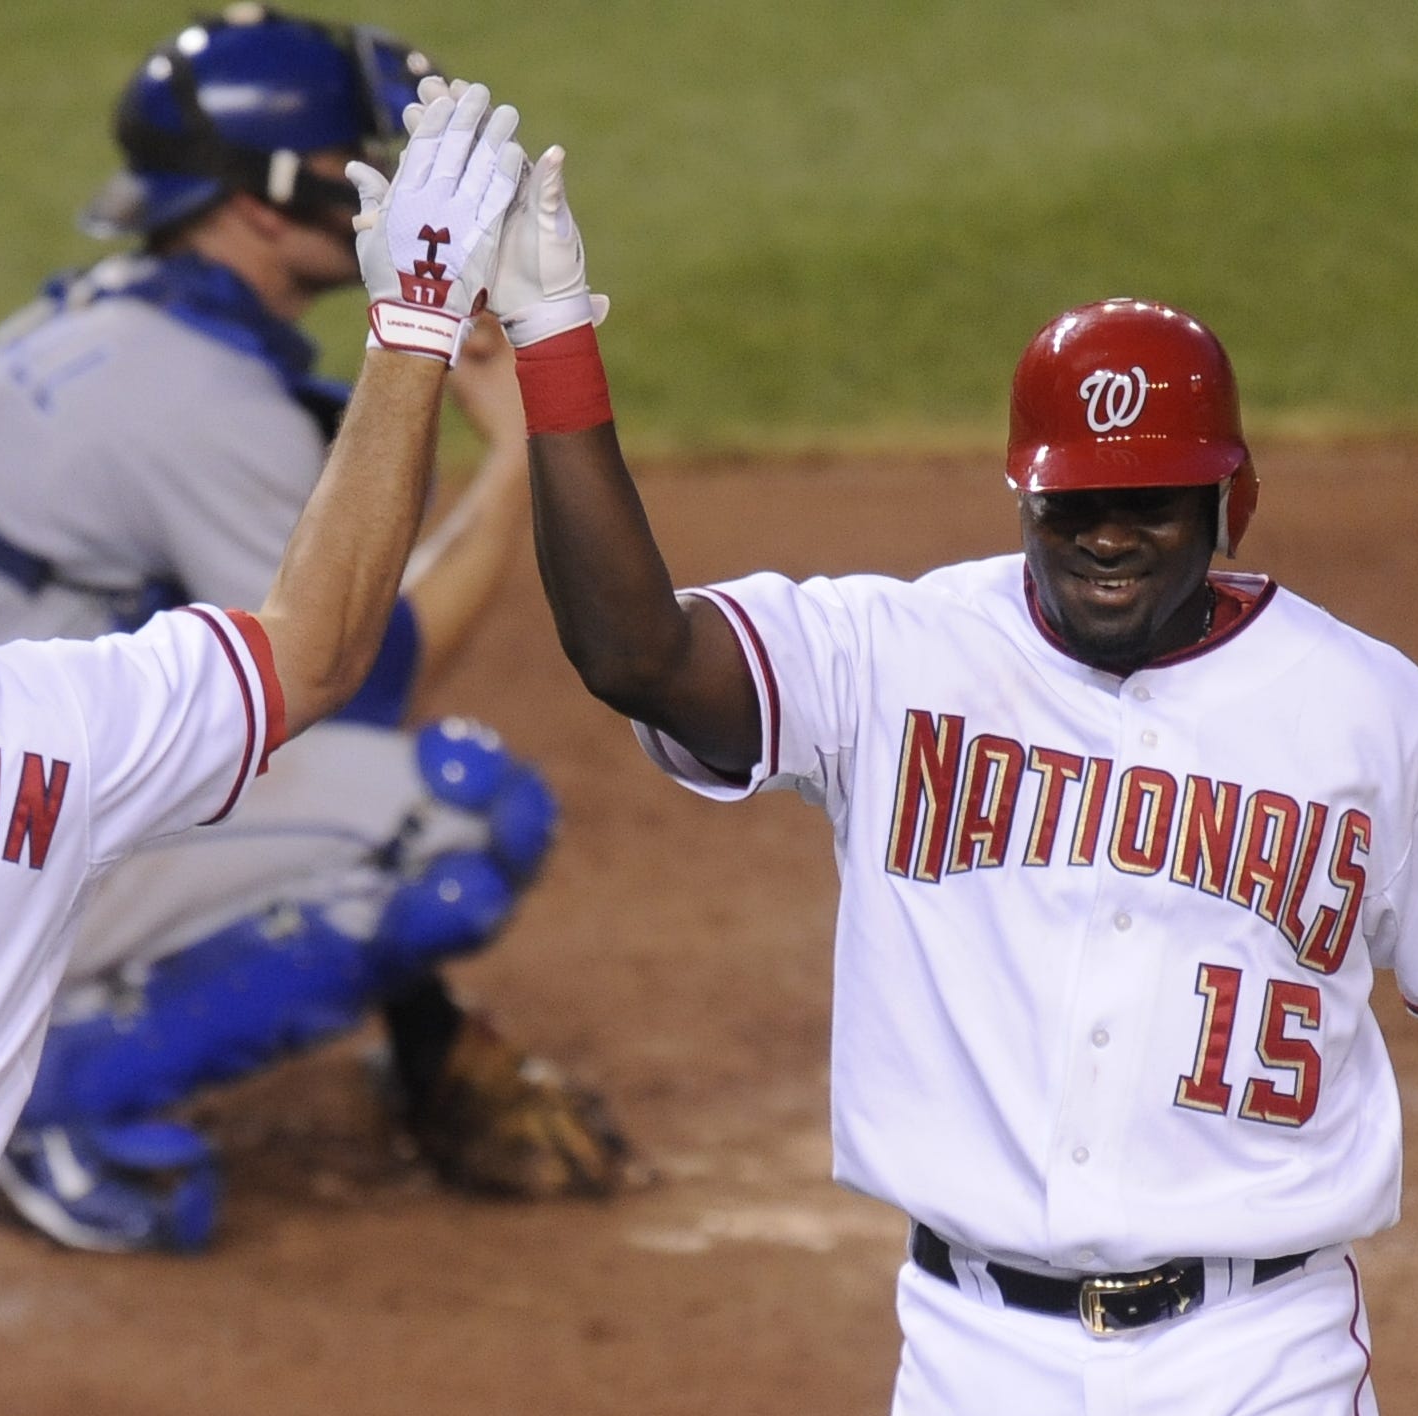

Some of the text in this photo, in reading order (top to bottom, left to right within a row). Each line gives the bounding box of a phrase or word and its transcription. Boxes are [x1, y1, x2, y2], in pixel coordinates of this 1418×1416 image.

[412, 285, 436, 304] 11
[1078, 365, 1147, 433] W
[885, 709, 1372, 974] NATIONALS
[1174, 963, 1321, 1128] 15
